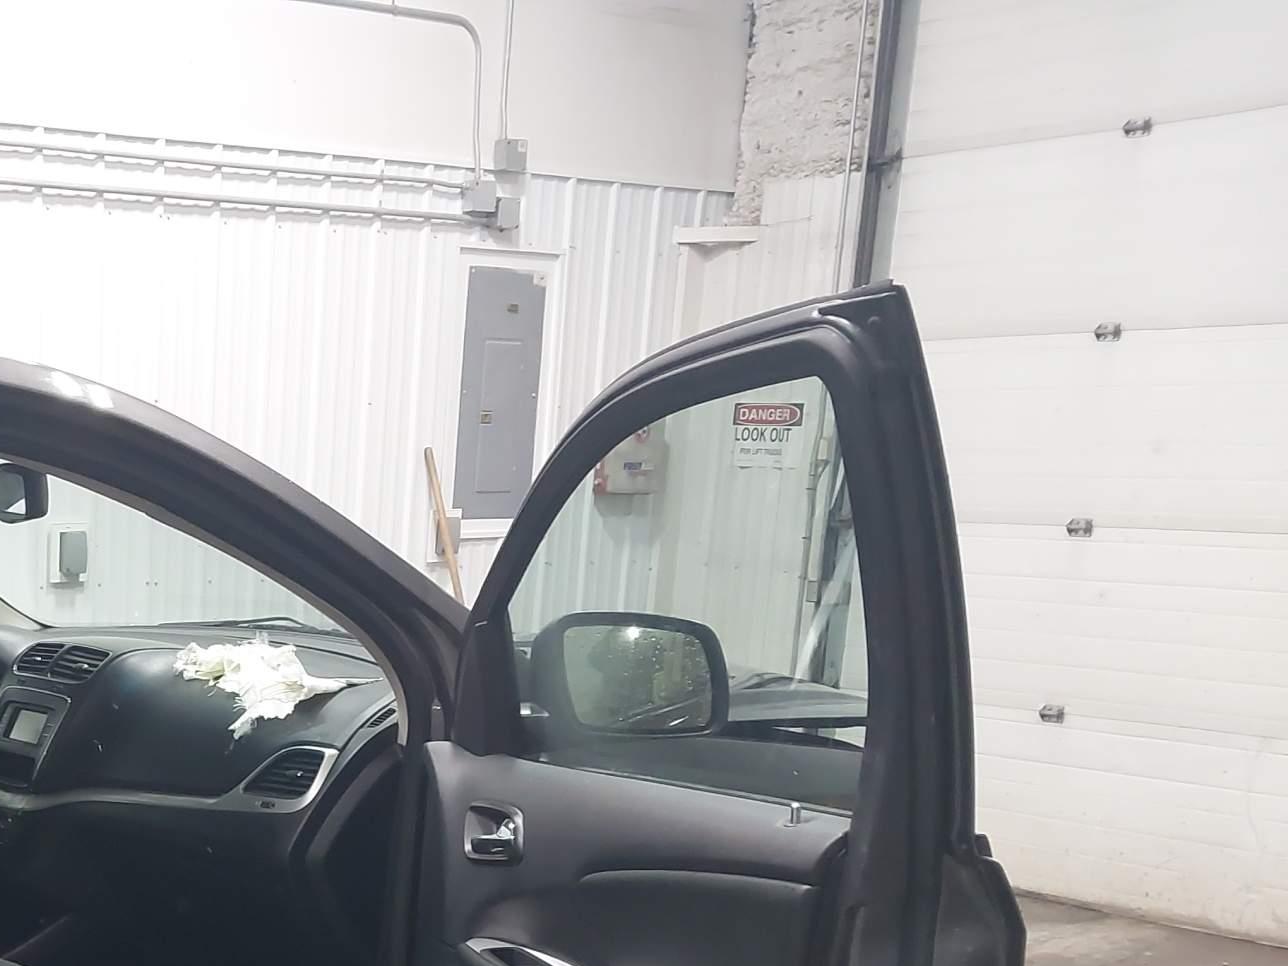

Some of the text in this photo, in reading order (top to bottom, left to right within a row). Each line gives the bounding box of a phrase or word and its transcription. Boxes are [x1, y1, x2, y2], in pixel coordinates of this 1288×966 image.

[739, 408, 790, 420] DANGER
[735, 427, 792, 442] LOOK OUT
